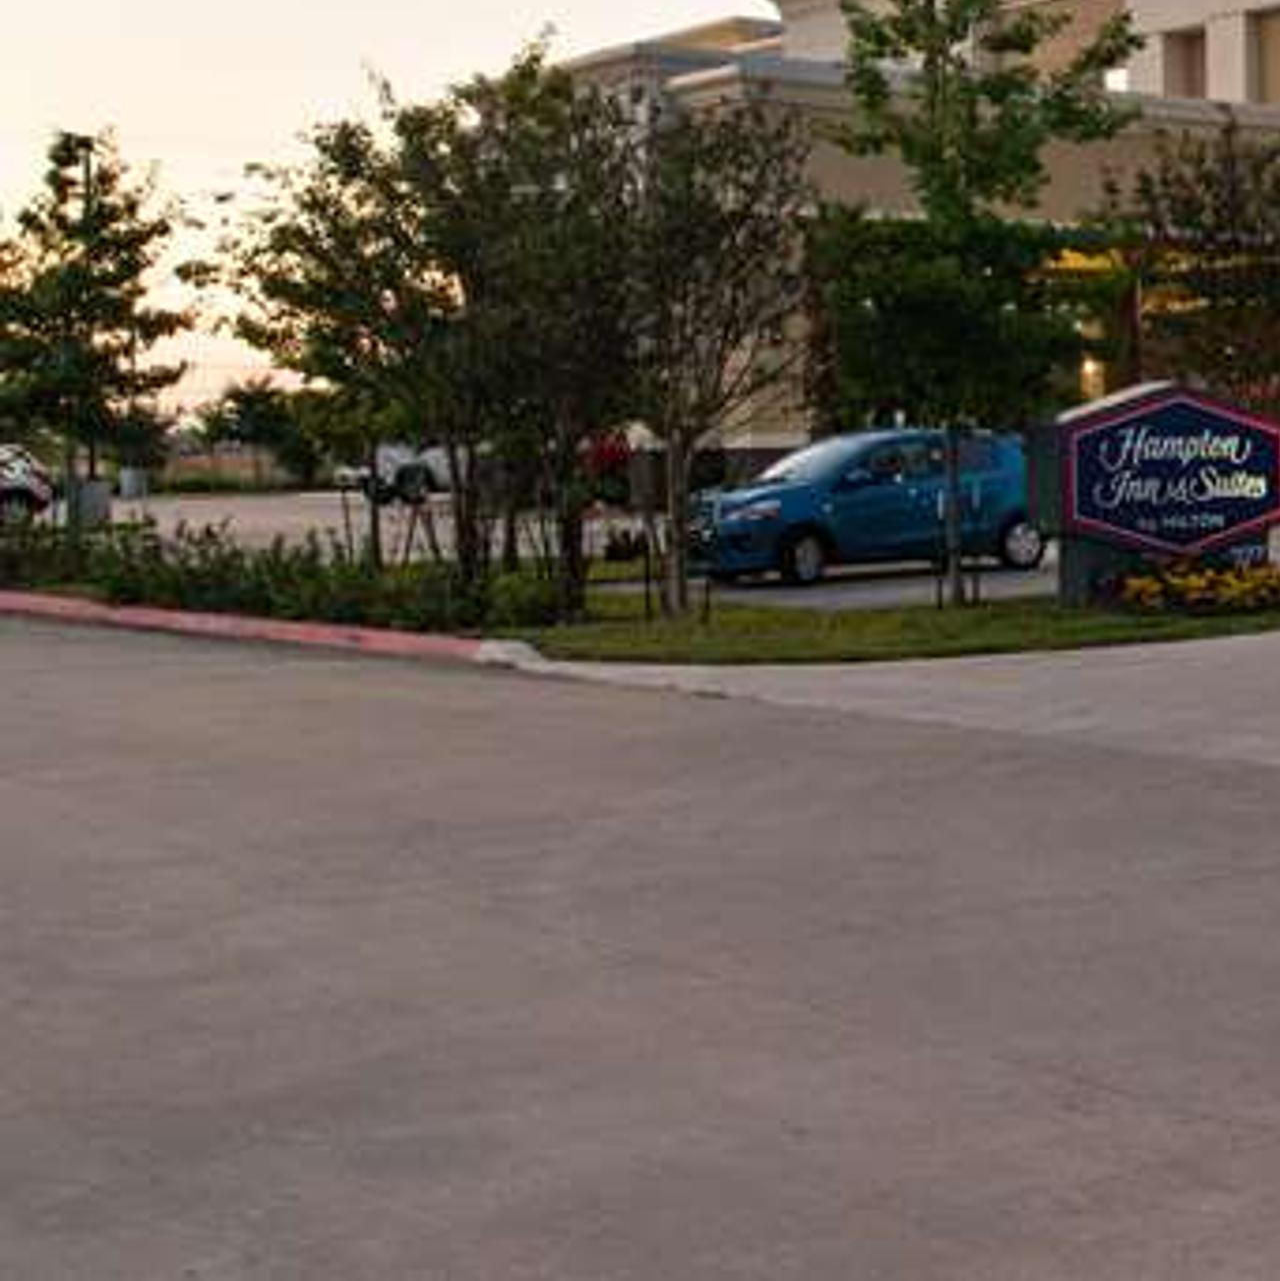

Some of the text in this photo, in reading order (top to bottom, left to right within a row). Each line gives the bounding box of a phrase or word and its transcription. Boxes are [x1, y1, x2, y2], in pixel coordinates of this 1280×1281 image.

[1099, 427, 1251, 470] Hampton
[1092, 470, 1172, 509] Inn
[1188, 465, 1268, 503] Suites
[1161, 512, 1225, 528] HILTON
